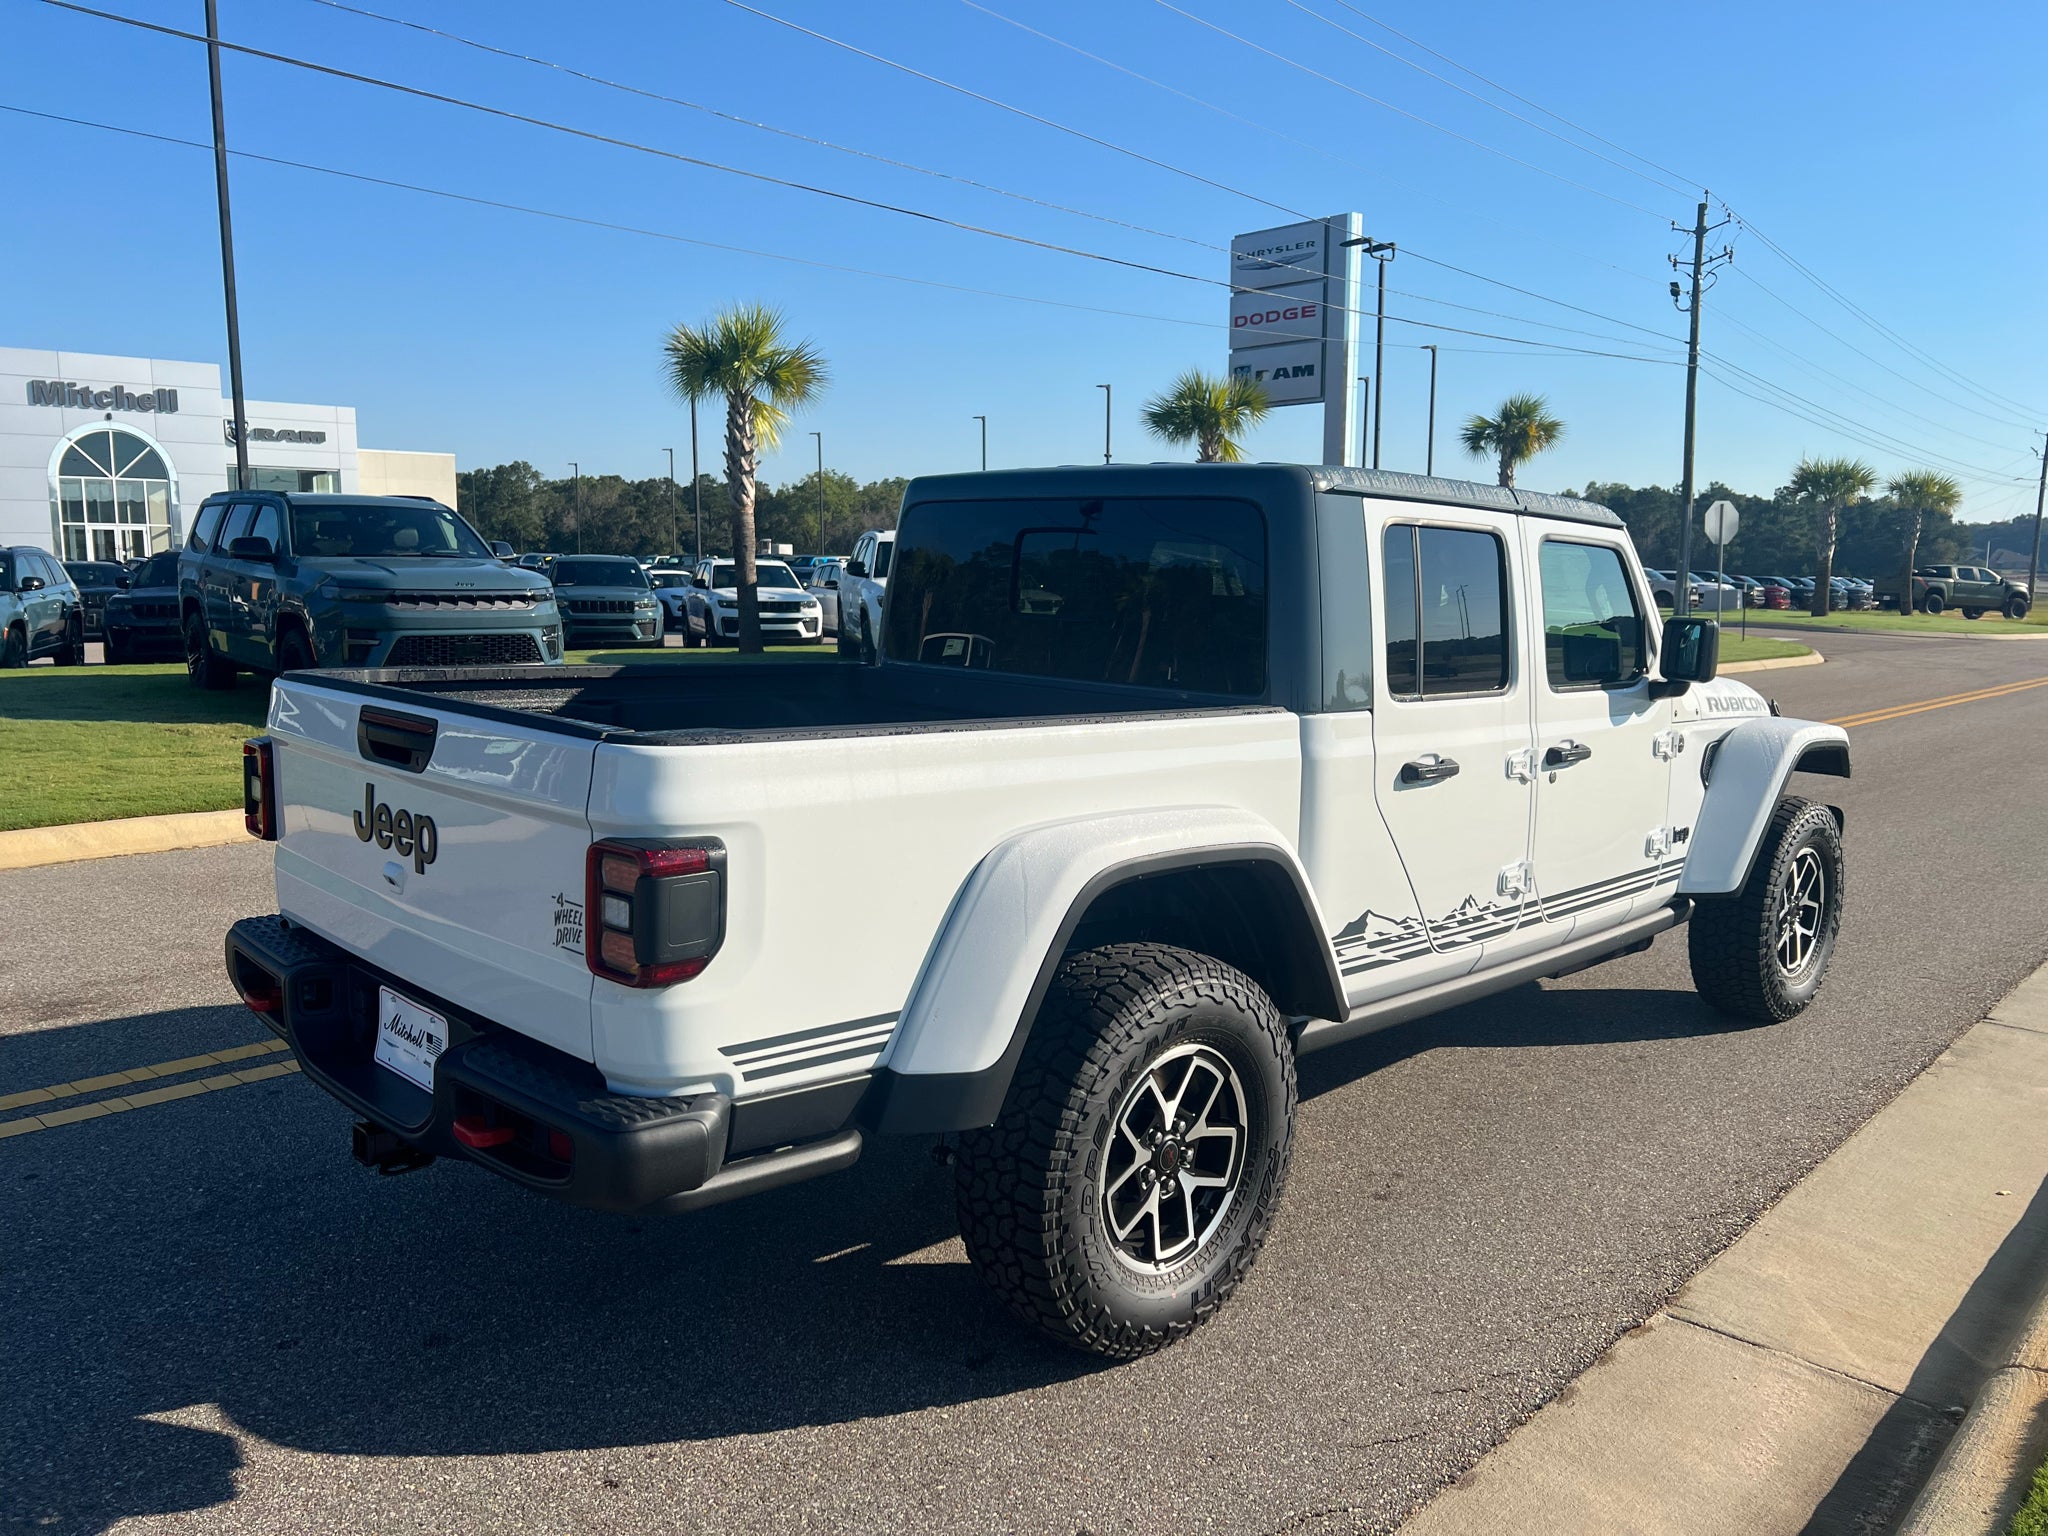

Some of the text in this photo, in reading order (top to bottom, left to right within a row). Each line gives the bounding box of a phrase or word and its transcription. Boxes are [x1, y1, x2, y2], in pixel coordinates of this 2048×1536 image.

[1237, 241, 1316, 260] CHRYSLER
[1234, 305, 1317, 328] DODGE
[27, 380, 178, 413] Mitchell
[250, 428, 326, 444] RAM
[1706, 696, 1768, 712] RUBICON
[354, 782, 437, 875] Jeep
[554, 908, 583, 926] WHEEL
[556, 927, 583, 947] DRIVE
[384, 1013, 425, 1048] Mitchell
